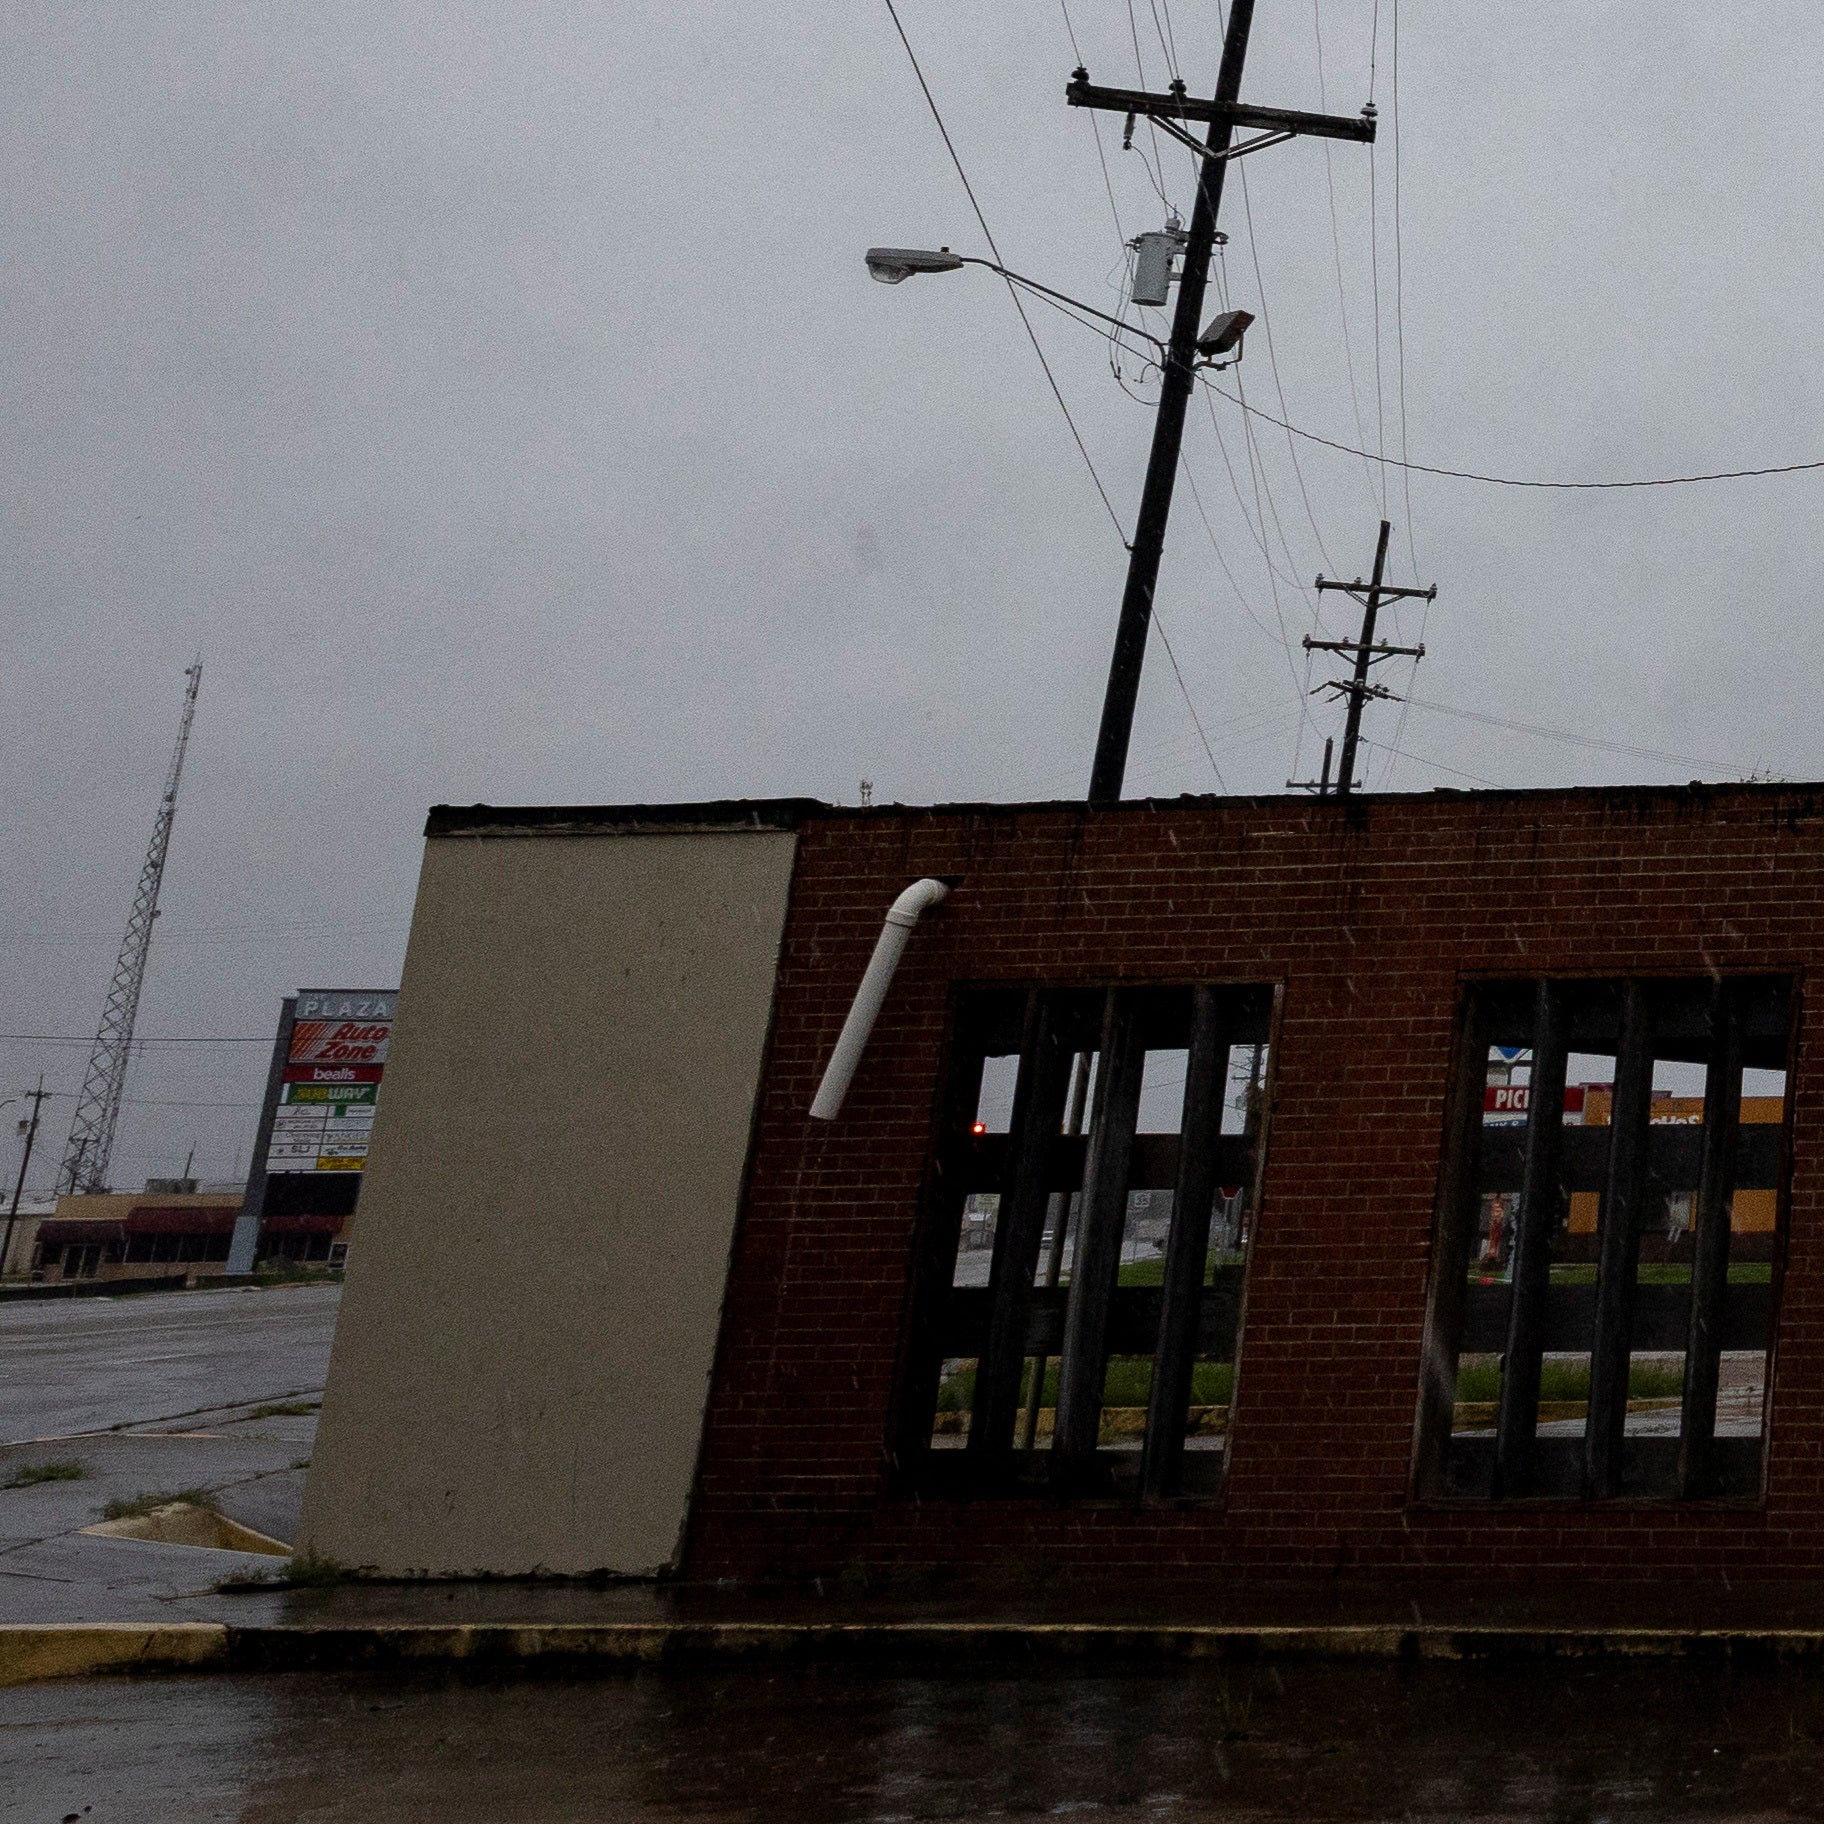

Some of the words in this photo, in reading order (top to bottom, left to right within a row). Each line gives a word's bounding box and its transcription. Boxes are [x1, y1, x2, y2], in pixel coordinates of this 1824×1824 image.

[303, 1002, 387, 1017] PLAZA
[331, 1021, 389, 1042] Auto
[314, 1040, 377, 1060] Zone
[313, 1067, 356, 1080] bealls
